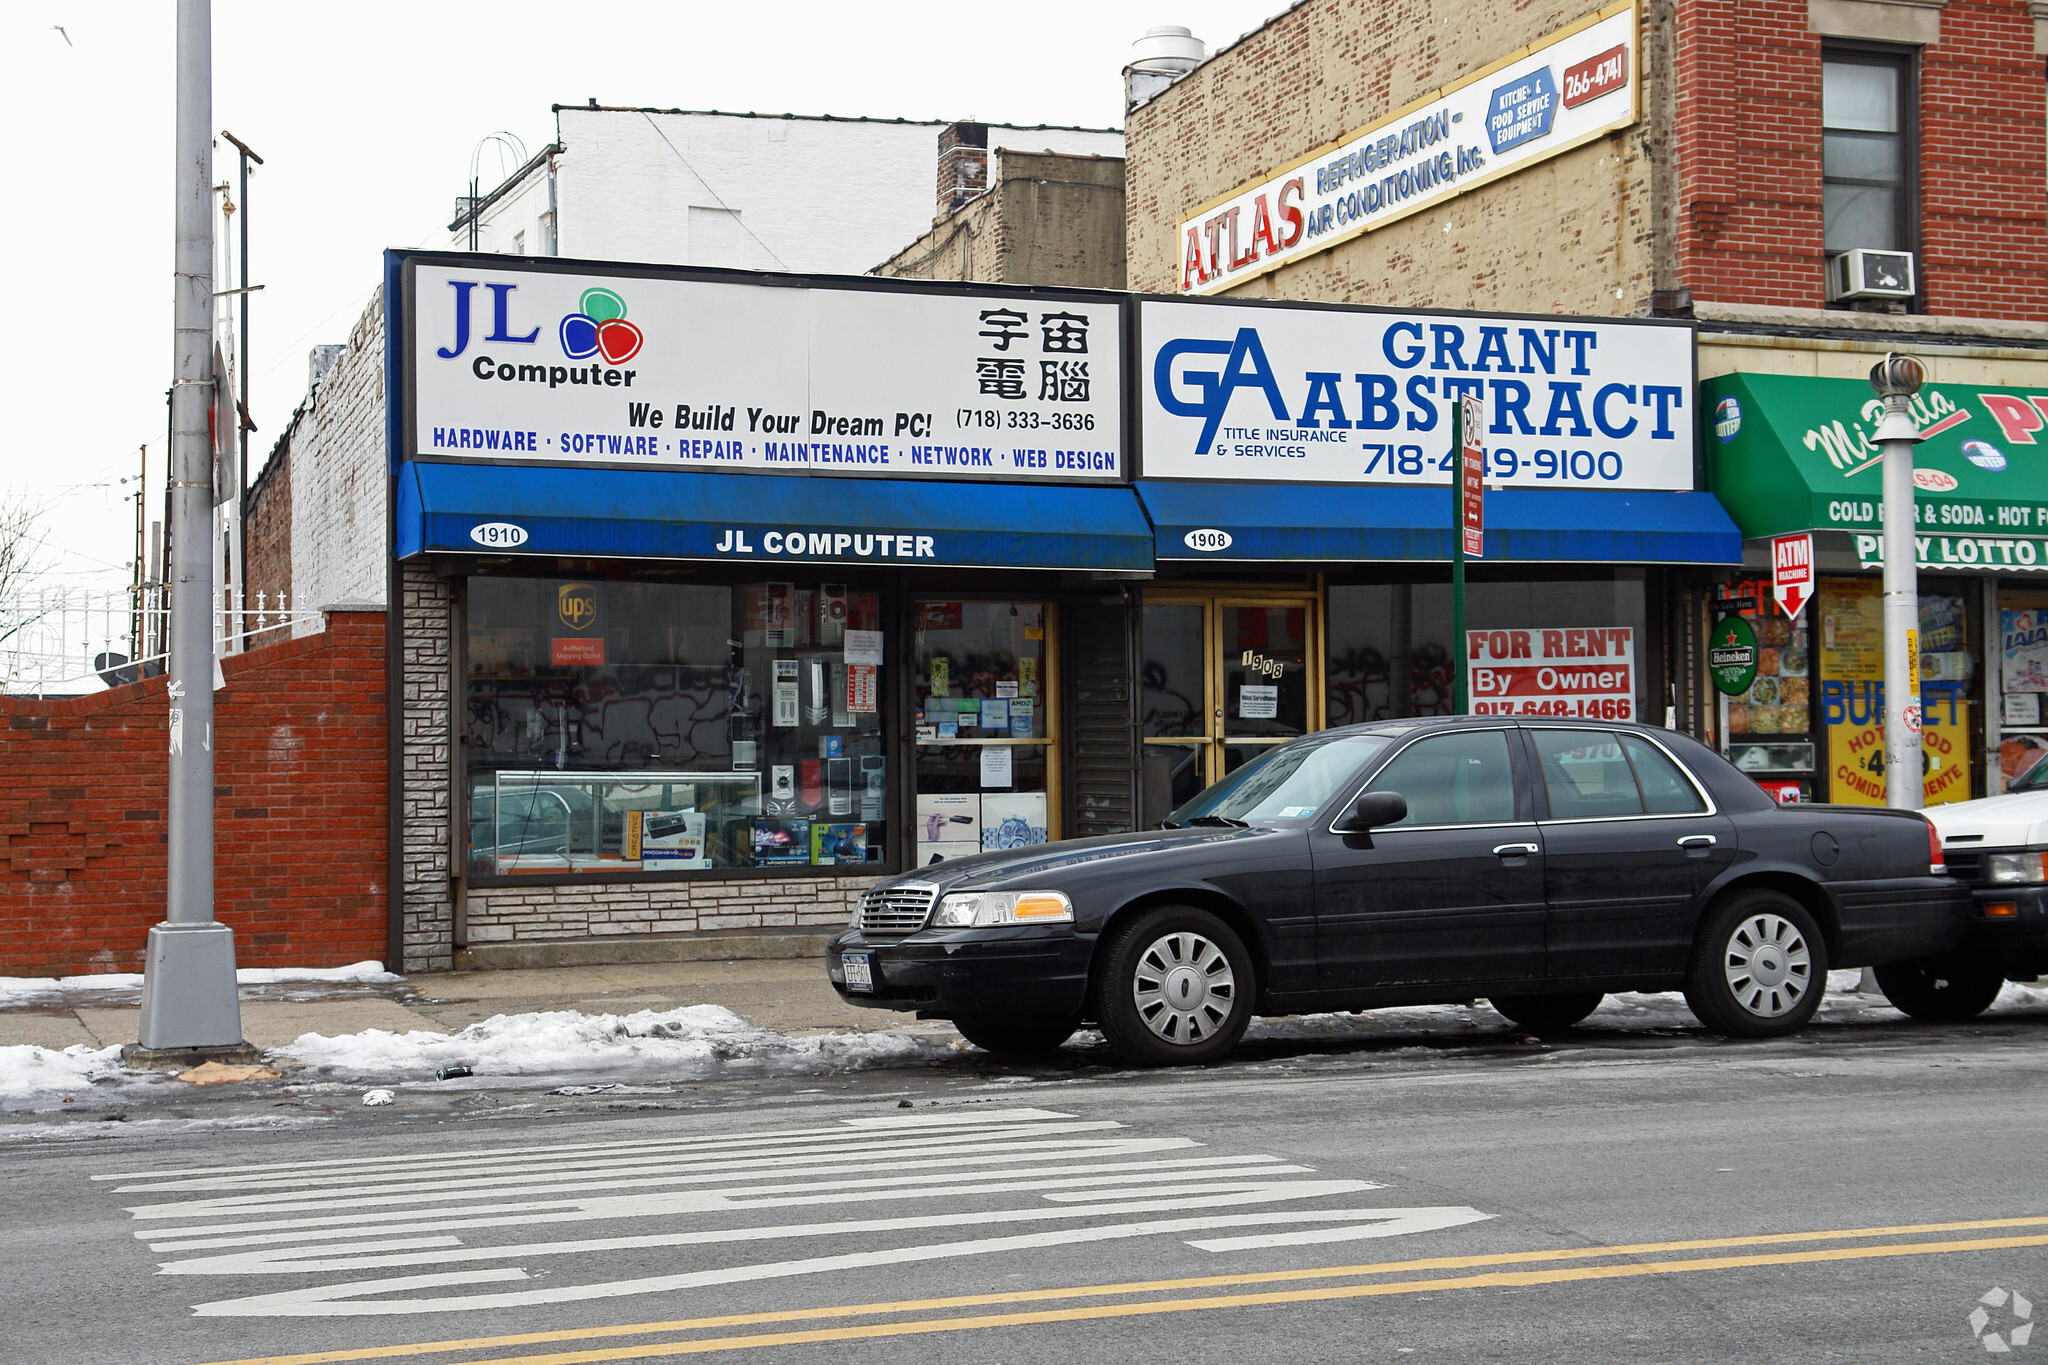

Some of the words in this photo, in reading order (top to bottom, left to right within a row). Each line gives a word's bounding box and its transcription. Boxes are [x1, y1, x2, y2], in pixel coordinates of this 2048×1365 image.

[1565, 53, 1623, 100] 266-4741
[1499, 82, 1533, 110] KITCHEN
[1535, 79, 1542, 94] &
[1491, 109, 1514, 131] FOOD
[1517, 93, 1550, 120] SERVICE
[1496, 113, 1543, 145] EQUIPMENT
[1316, 118, 1450, 196] REFRIGERATION
[1181, 176, 1305, 291] ATLAS
[1306, 200, 1334, 239] AIR
[436, 280, 541, 360] JL
[978, 307, 1091, 354] 宇宙
[1382, 321, 1598, 376] GRANT
[472, 355, 637, 388] Computer
[976, 357, 1091, 402] 電腦
[629, 402, 663, 428] We
[675, 404, 735, 432] Build
[747, 408, 800, 434] Your
[811, 410, 884, 437] Dream
[895, 412, 933, 438] PC!
[956, 409, 1001, 431] (718)
[1007, 411, 1095, 431] 333-3636
[1296, 371, 1684, 440] ABSTRACT
[1976, 393, 2048, 445] P
[1223, 427, 1260, 440] TITLE
[1266, 429, 1347, 443] INSURANCE
[1803, 419, 1879, 470] Mi
[1861, 390, 1956, 430] Blla
[434, 427, 537, 451] HARDWARE
[560, 433, 658, 456] SOFTWARE
[679, 439, 743, 460] REPAIR
[765, 442, 890, 464] MAINTENANCE
[911, 446, 994, 467] NETWORK
[1012, 449, 1048, 469] WEB
[1055, 450, 1116, 471] DESIGN
[1216, 444, 1228, 456] &
[1234, 445, 1306, 458] SERVICES
[1913, 472, 1955, 488] 9-04
[1829, 500, 1874, 522] COLD
[1878, 502, 1921, 524] BR
[1925, 504, 1937, 524] &
[1941, 504, 1986, 526] SODA
[1999, 506, 2031, 526] HOT
[477, 527, 521, 544] 1910
[716, 530, 753, 553] JL
[763, 532, 936, 558] COMPUTER
[1191, 533, 1226, 548] 1908
[1857, 535, 1932, 561] PY
[1941, 537, 2037, 566] LOTTO
[1777, 539, 1809, 569] ATM
[1778, 568, 1808, 582] MACHINE
[562, 597, 593, 624] ups
[1736, 599, 1753, 608] Here
[1469, 631, 1532, 660] FOR
[1542, 629, 1631, 658] RENT
[1713, 651, 1750, 663] Heineken
[1243, 651, 1282, 677] 1908
[1477, 669, 1512, 695] By
[1536, 667, 1625, 690] Owner
[1474, 699, 1631, 720] 917-648-1466
[1848, 726, 1885, 754] HOT
